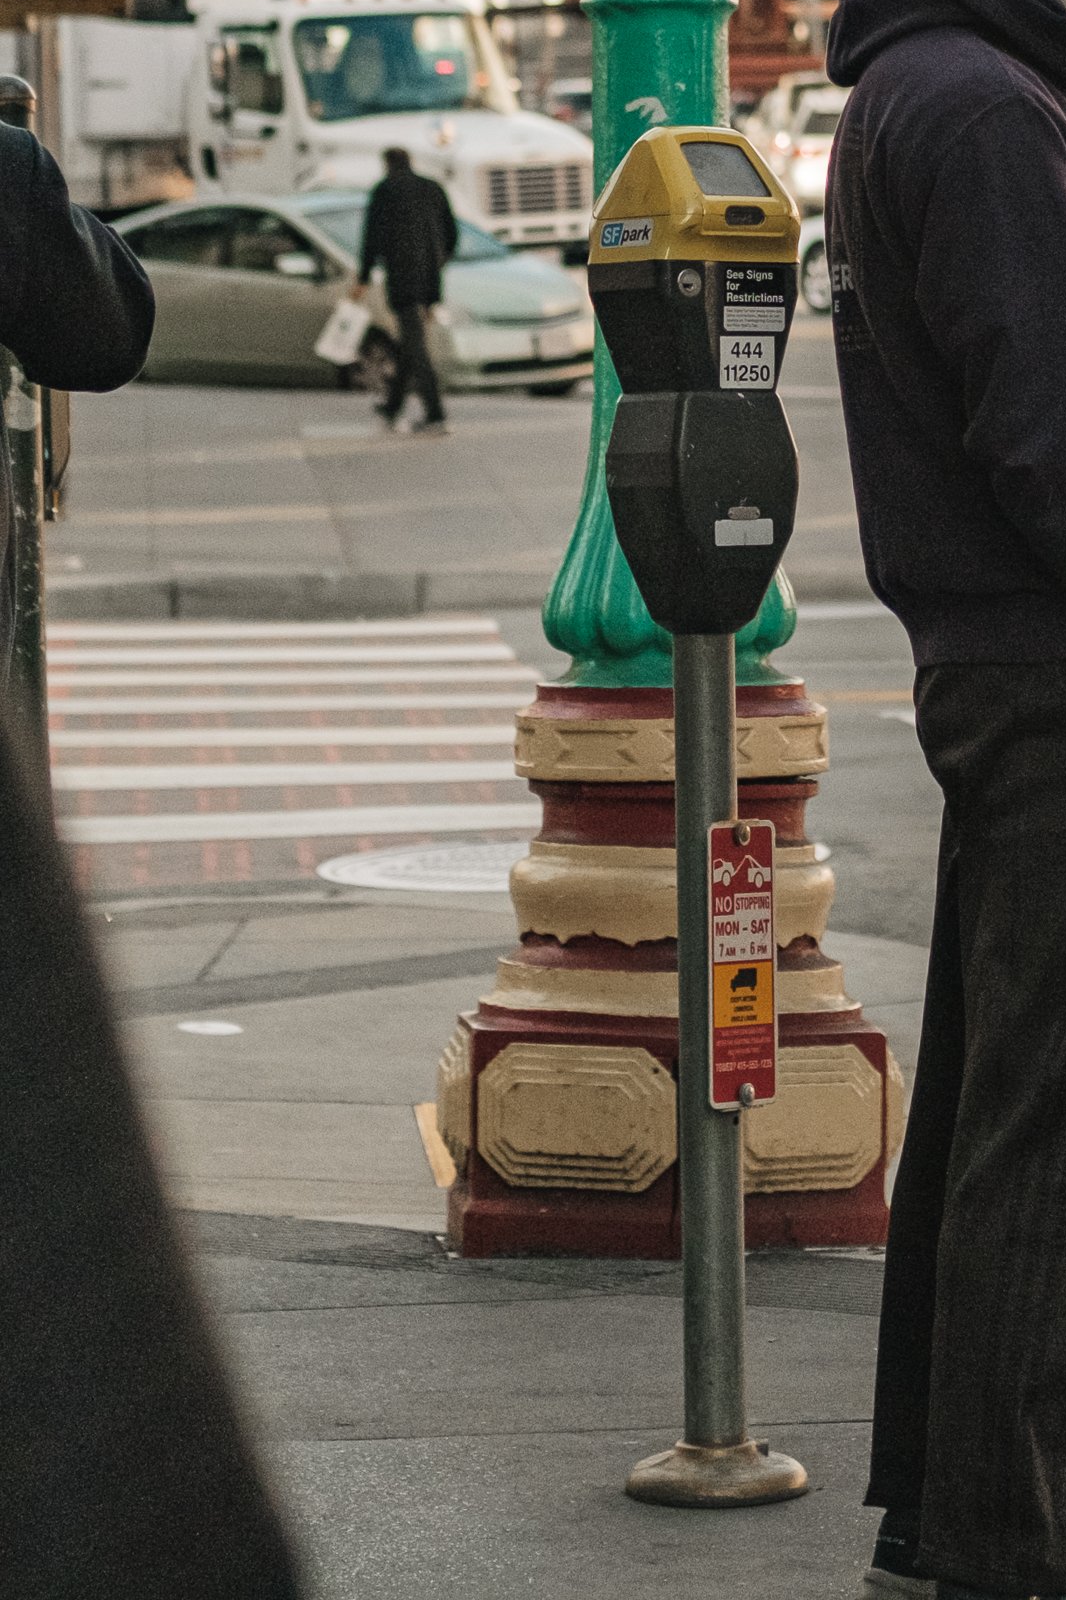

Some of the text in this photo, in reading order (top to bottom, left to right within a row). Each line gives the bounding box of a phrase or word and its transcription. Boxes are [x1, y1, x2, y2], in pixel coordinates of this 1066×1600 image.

[726, 269, 774, 282] See Signs
[726, 281, 740, 291] for
[726, 292, 784, 303] Restrictions
[730, 341, 763, 358] 444
[723, 364, 770, 382] 11250
[715, 896, 769, 913] NO STOPPING
[715, 921, 740, 936] MON
[750, 919, 770, 934] SAT
